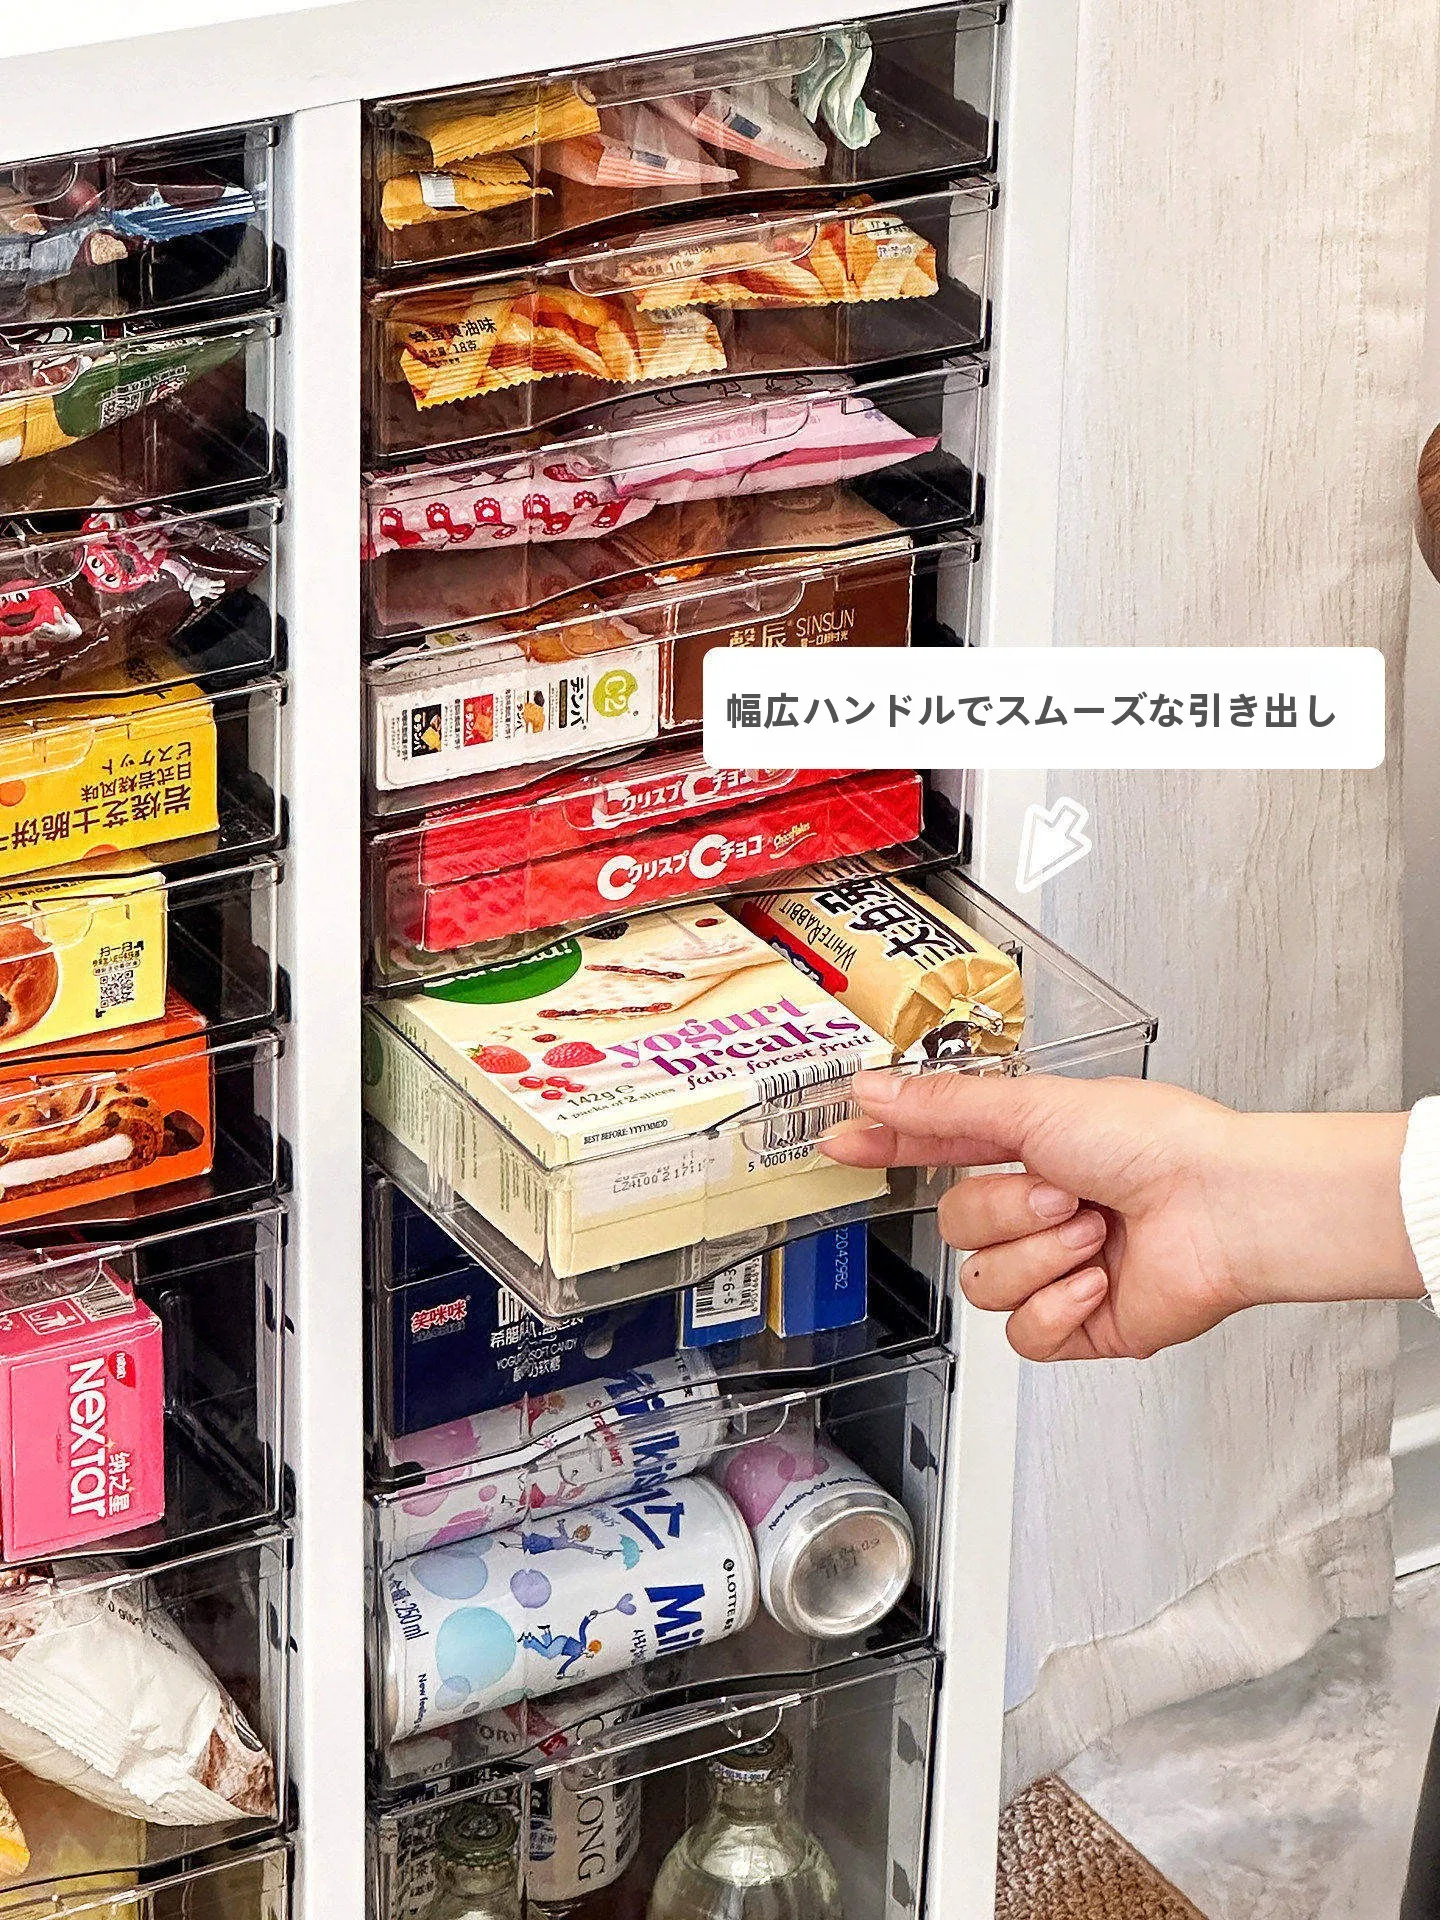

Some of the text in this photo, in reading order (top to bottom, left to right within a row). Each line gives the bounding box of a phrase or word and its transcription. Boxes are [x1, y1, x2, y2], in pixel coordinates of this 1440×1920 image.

[795, 608, 855, 638] SINSUN
[102, 741, 191, 775] ビスケット
[80, 761, 191, 802] 日式岩烧风味
[605, 994, 811, 1068] yogurt
[652, 1016, 861, 1081] breaks
[687, 1034, 875, 1091] fab! forest fruit
[583, 1134, 600, 1145] BEST
[748, 1149, 809, 1172] 5 000168
[108, 1451, 130, 1516] 纳之星
[726, 1573, 737, 1618] LOTTE
[417, 1673, 427, 1697] New
